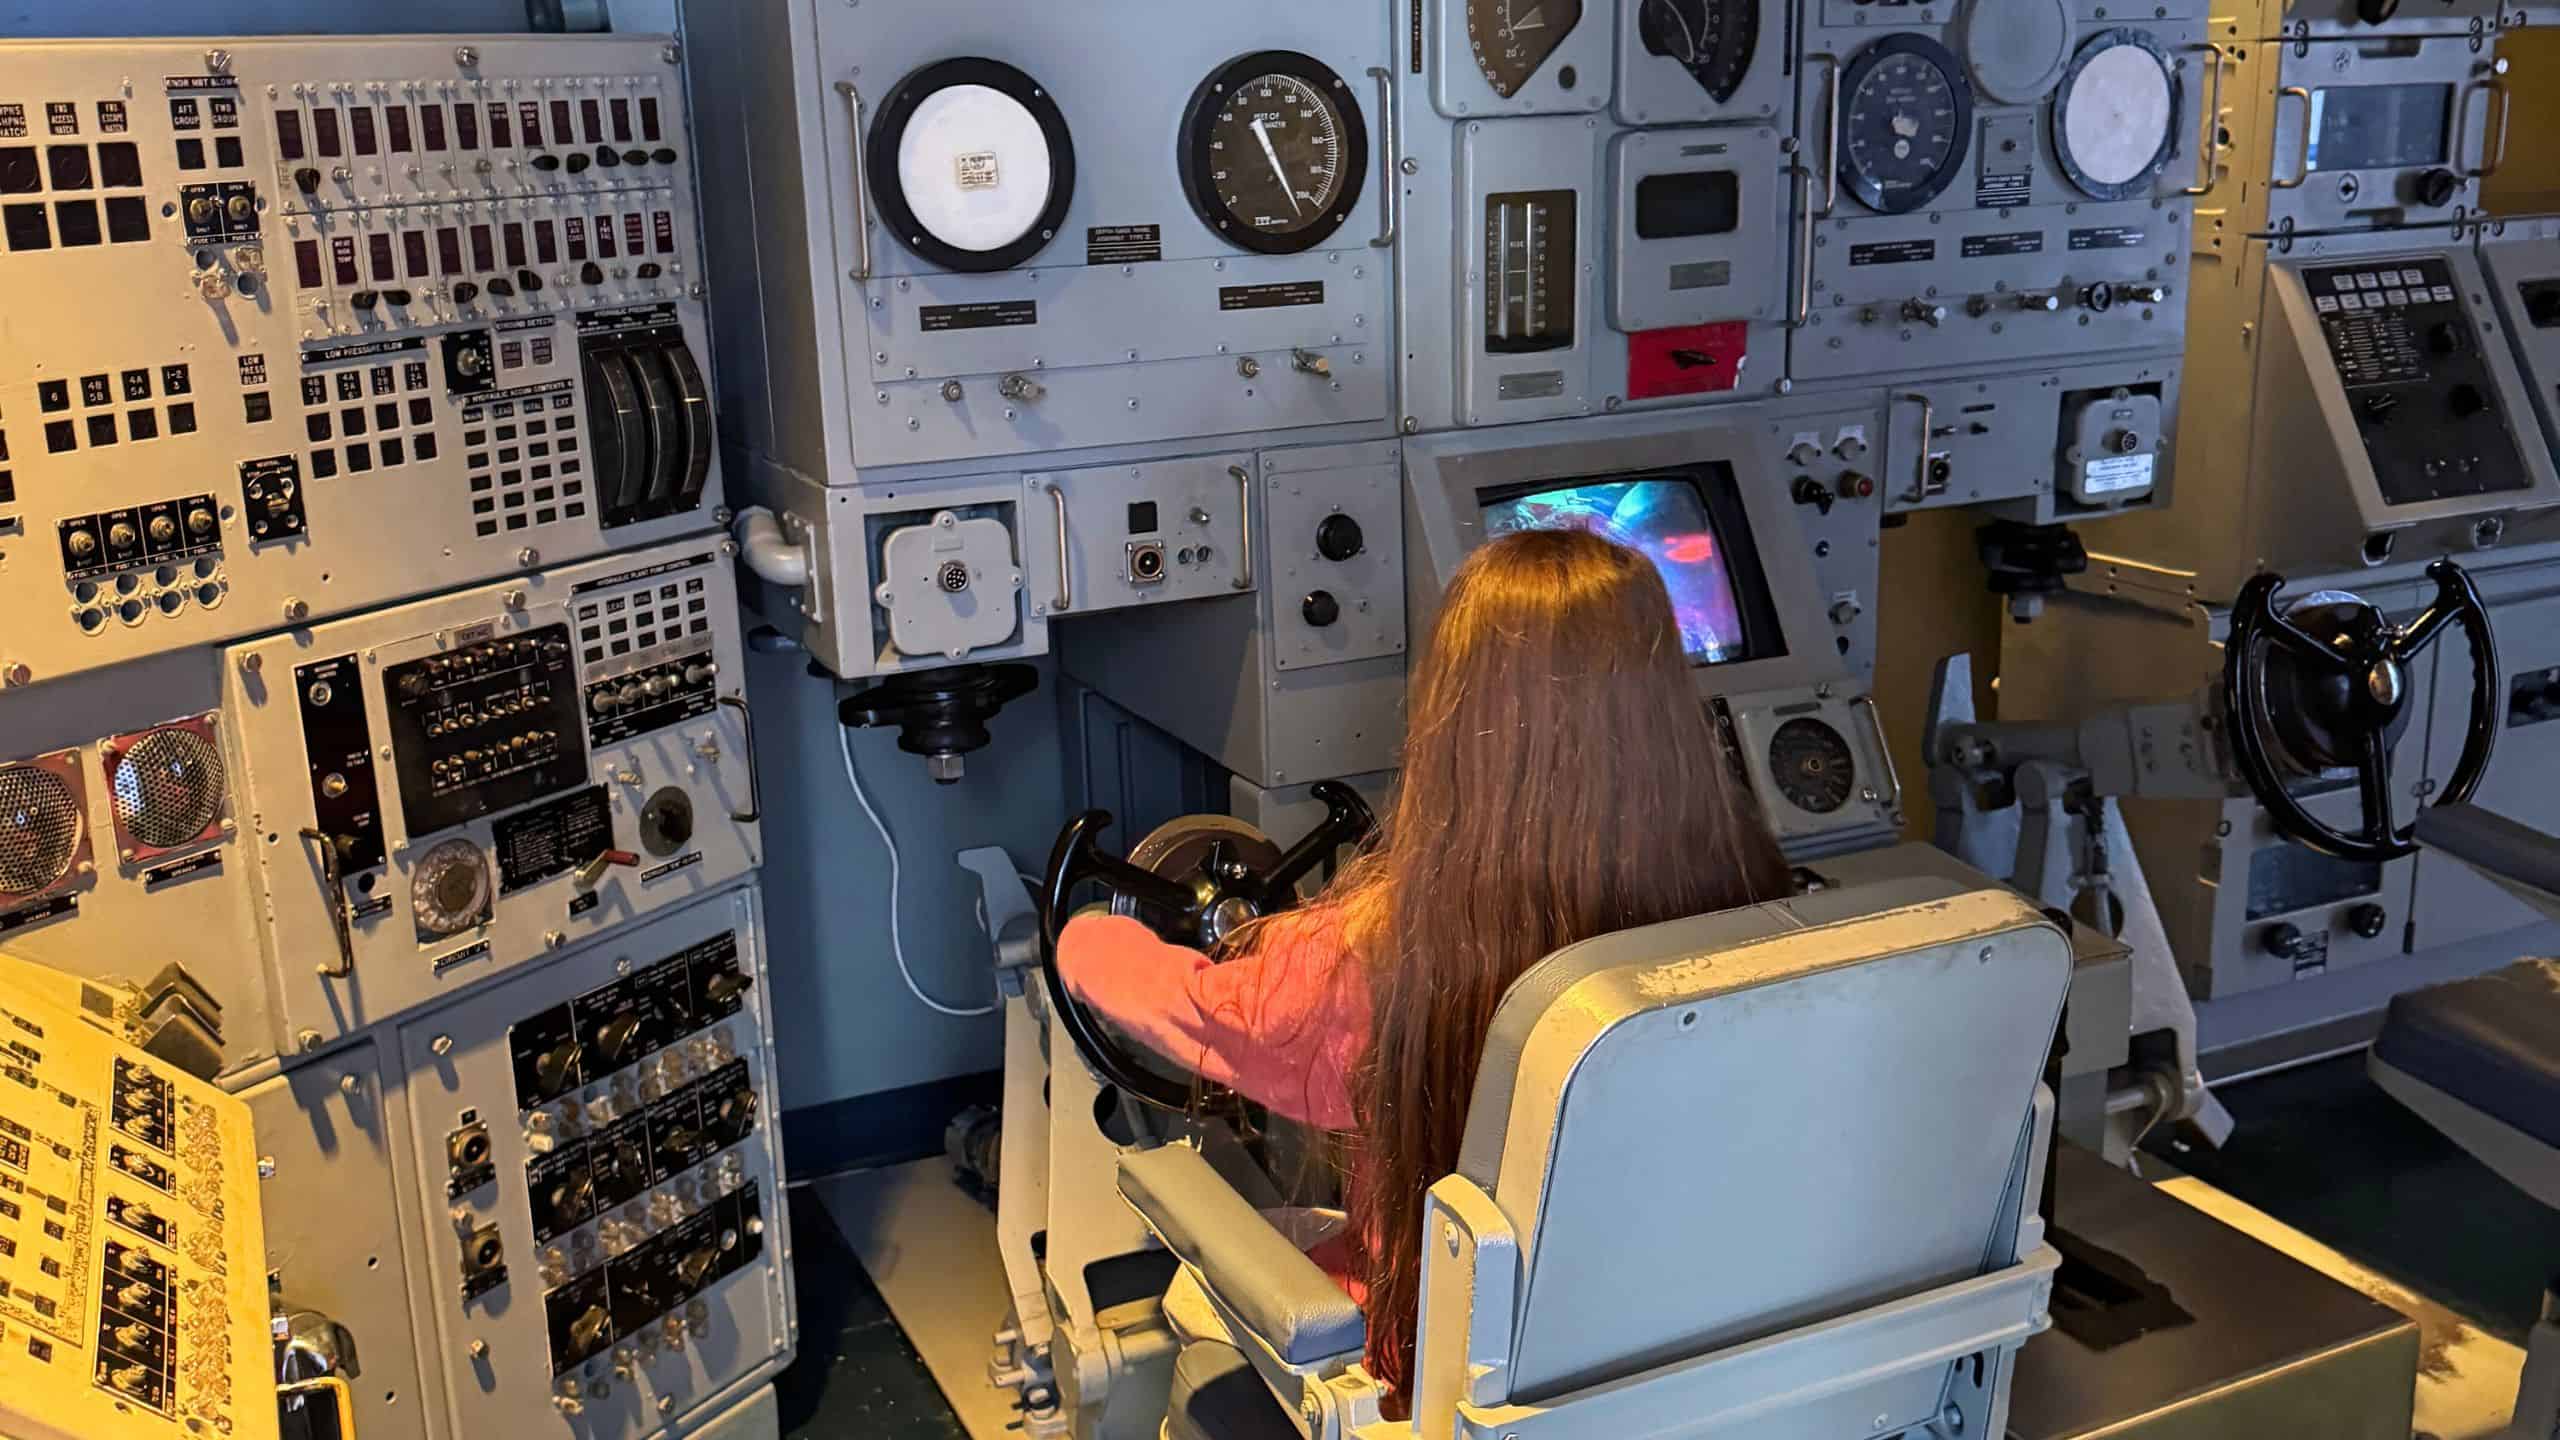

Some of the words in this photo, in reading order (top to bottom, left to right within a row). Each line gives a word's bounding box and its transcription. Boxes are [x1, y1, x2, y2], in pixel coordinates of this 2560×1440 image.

[1260, 88, 1273, 97] 100
[325, 350, 341, 360] LOW
[243, 356, 260, 366] LOW
[239, 365, 265, 376] PRESS
[128, 375, 144, 385] 4A
[130, 386, 146, 396] 5A
[89, 391, 105, 403] 5B
